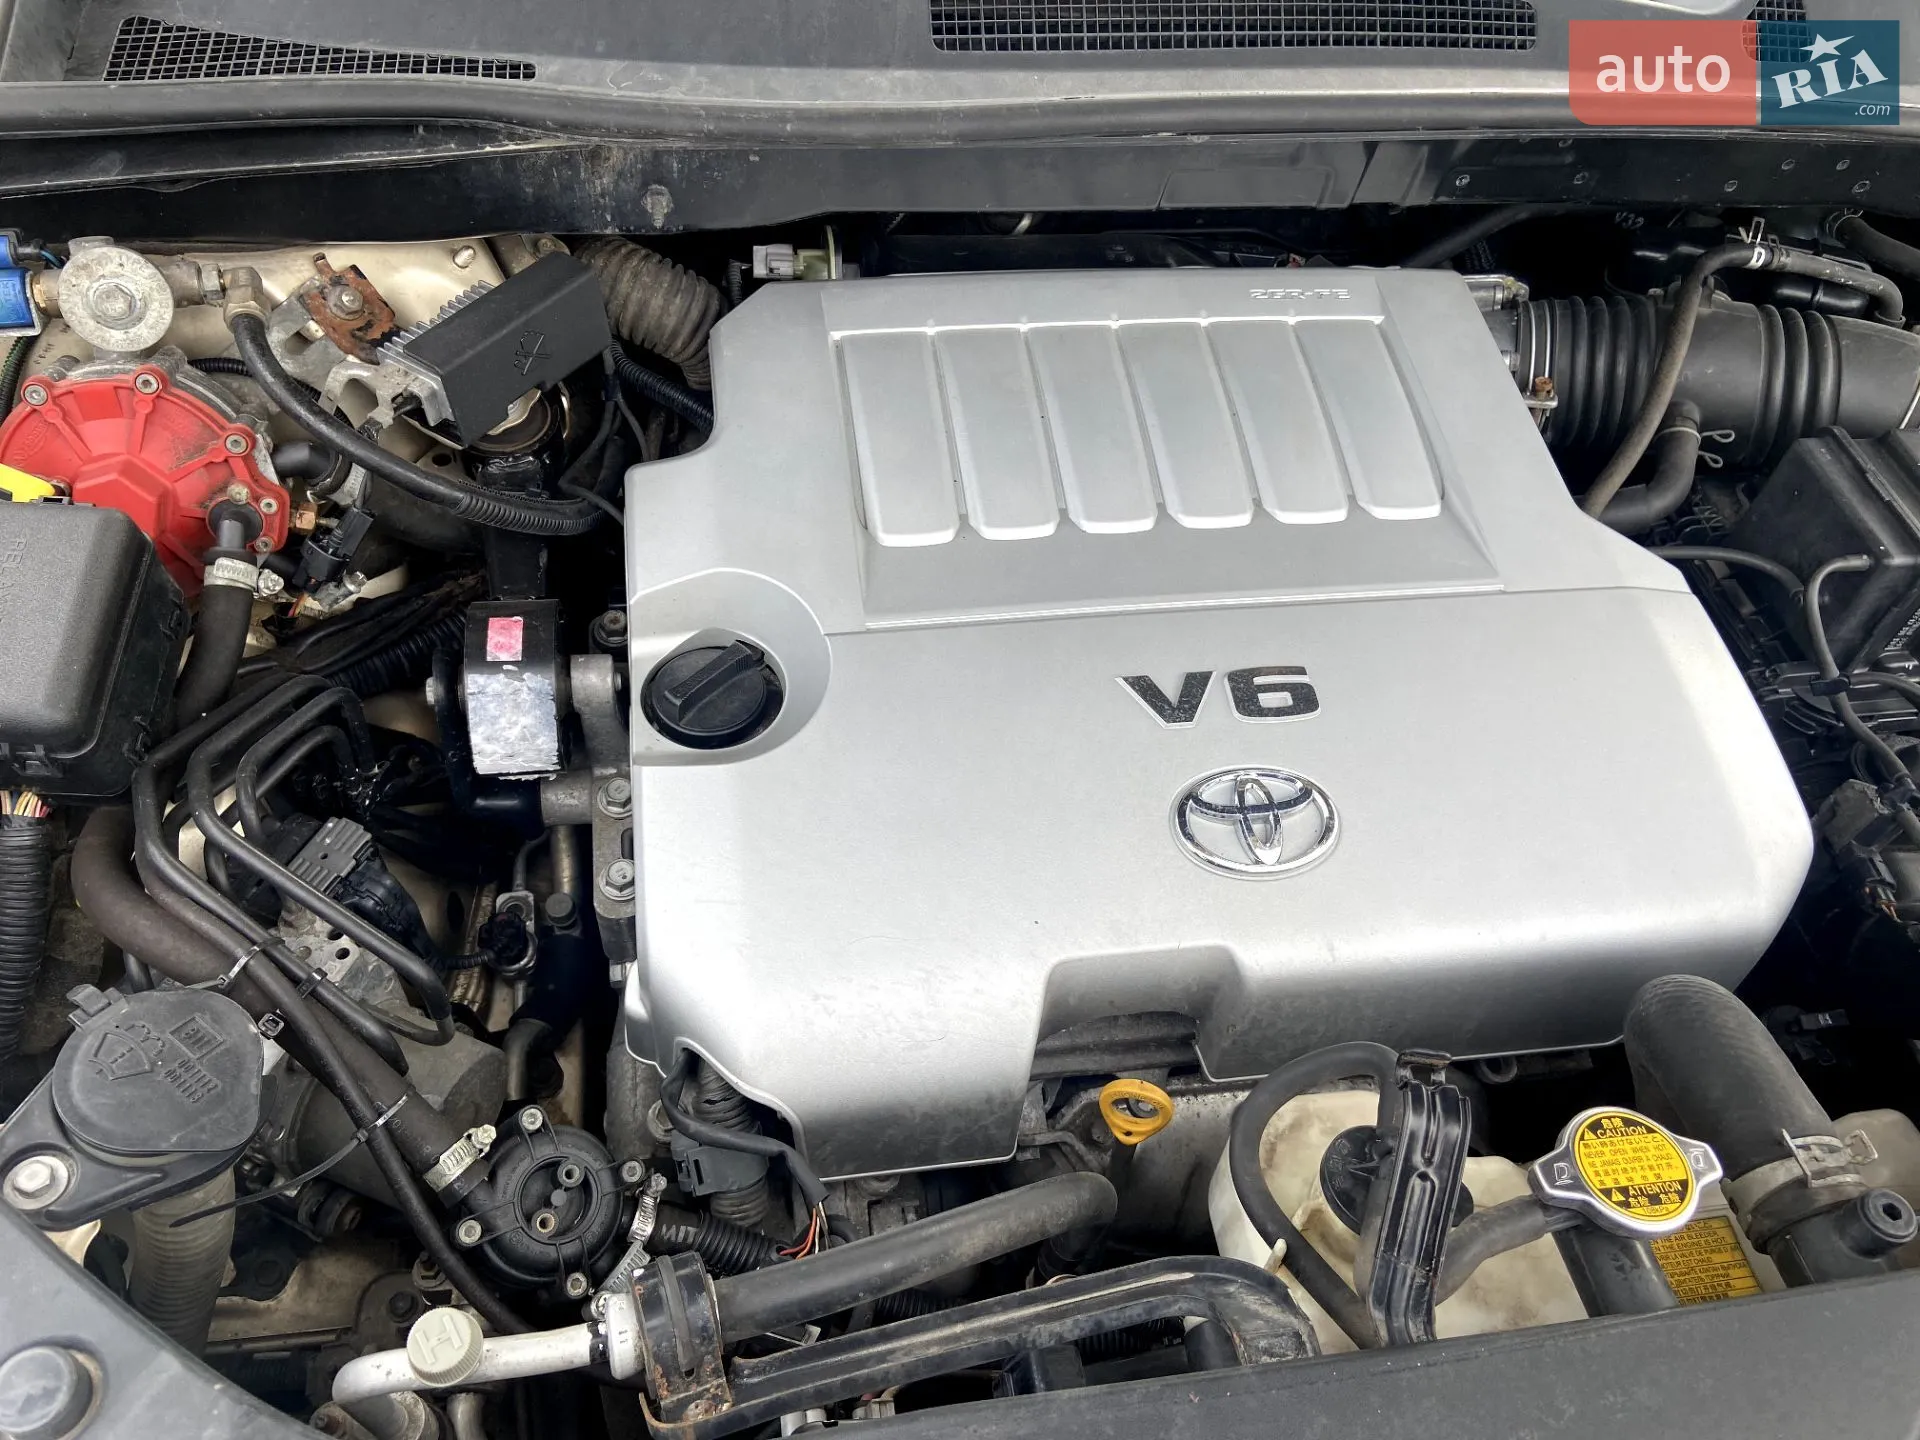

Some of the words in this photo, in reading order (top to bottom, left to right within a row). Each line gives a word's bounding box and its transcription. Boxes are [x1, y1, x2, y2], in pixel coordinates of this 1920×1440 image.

[1114, 665, 1321, 729] V6
[1596, 1125, 1647, 1139] CAUTION
[1583, 1150, 1606, 1160] NEVER
[1609, 1147, 1629, 1157] OPEN
[1631, 1145, 1651, 1155] WHEN
[1653, 1143, 1668, 1153] HOT
[1628, 1180, 1682, 1197] ATTENTION
[1660, 1235, 1674, 1244] THE
[1674, 1233, 1686, 1242] AIR
[1687, 1230, 1719, 1240] BLEEDER
[1661, 1242, 1674, 1251] THE
[1676, 1239, 1704, 1250] ENGINE
[1704, 1238, 1711, 1247] IS
